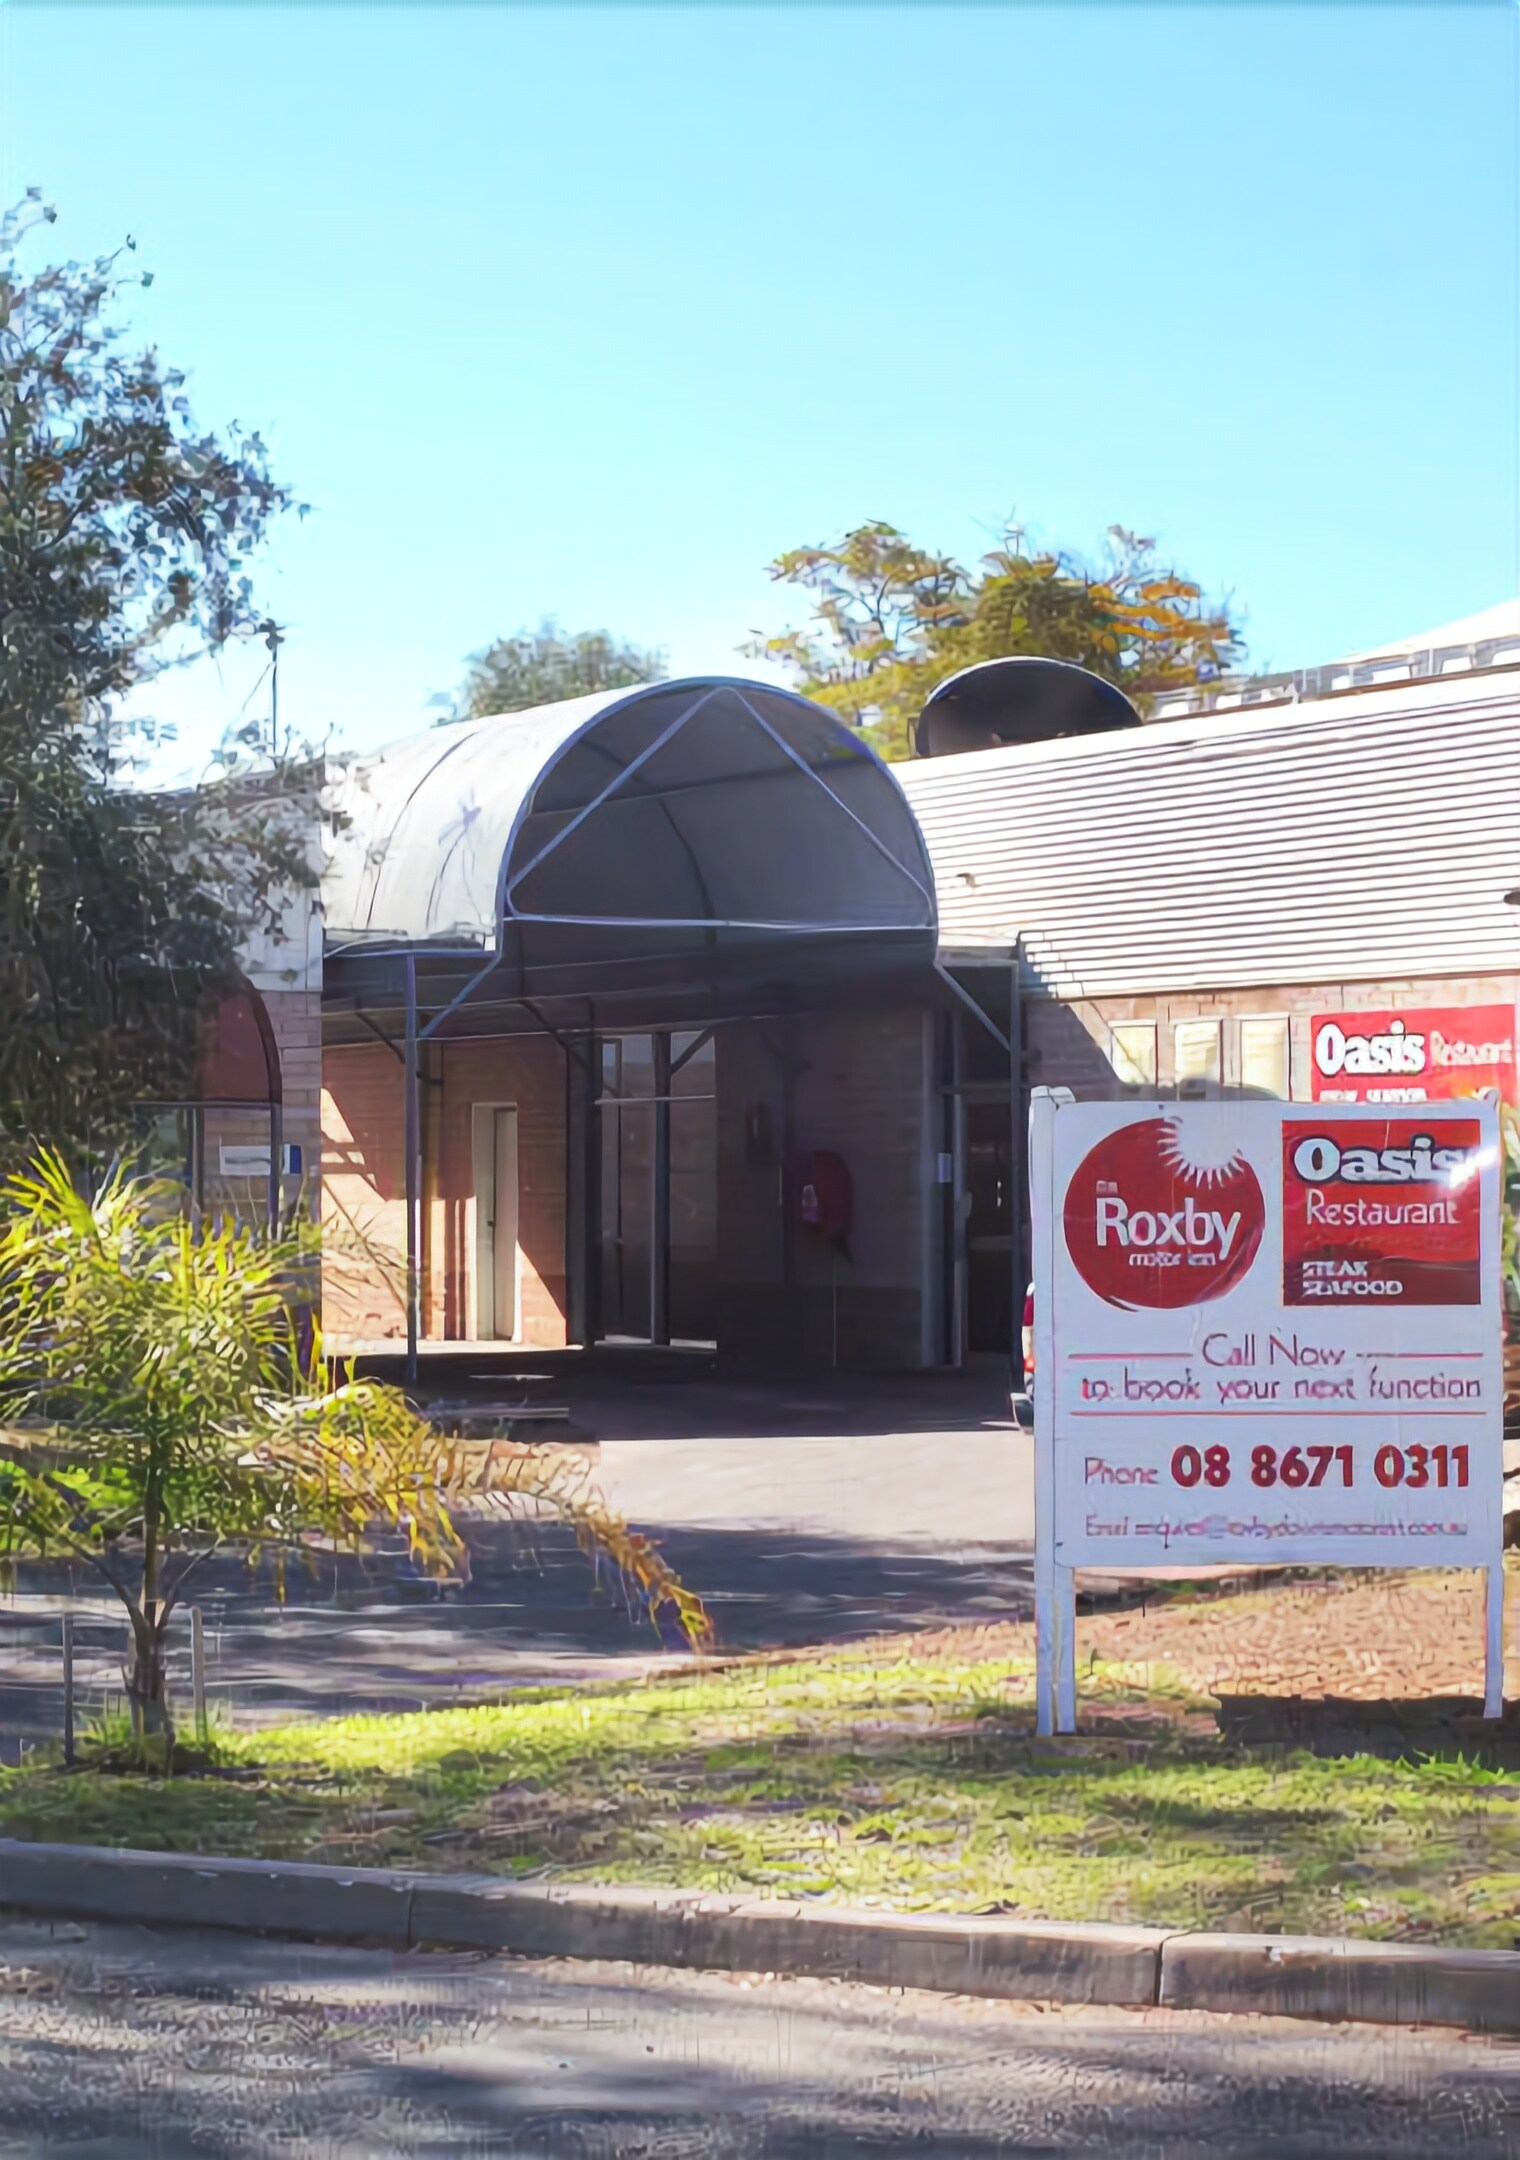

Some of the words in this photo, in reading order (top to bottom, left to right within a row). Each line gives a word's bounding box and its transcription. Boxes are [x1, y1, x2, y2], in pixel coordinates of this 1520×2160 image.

[1315, 1019, 1426, 1076] Oasis
[1293, 1135, 1466, 1184] Oasis
[1306, 1188, 1460, 1225] Restaurant
[1096, 1197, 1241, 1260] Roxby
[1202, 1333, 1255, 1366] Call
[1269, 1334, 1345, 1366] Now
[1124, 1366, 1200, 1400] book
[1217, 1380, 1280, 1406] your
[1294, 1378, 1355, 1399] next
[1370, 1365, 1481, 1399] function
[1085, 1457, 1160, 1485] Phone
[1171, 1445, 1231, 1487] 08
[1251, 1444, 1353, 1487] 8671
[1374, 1444, 1469, 1487] 0311
